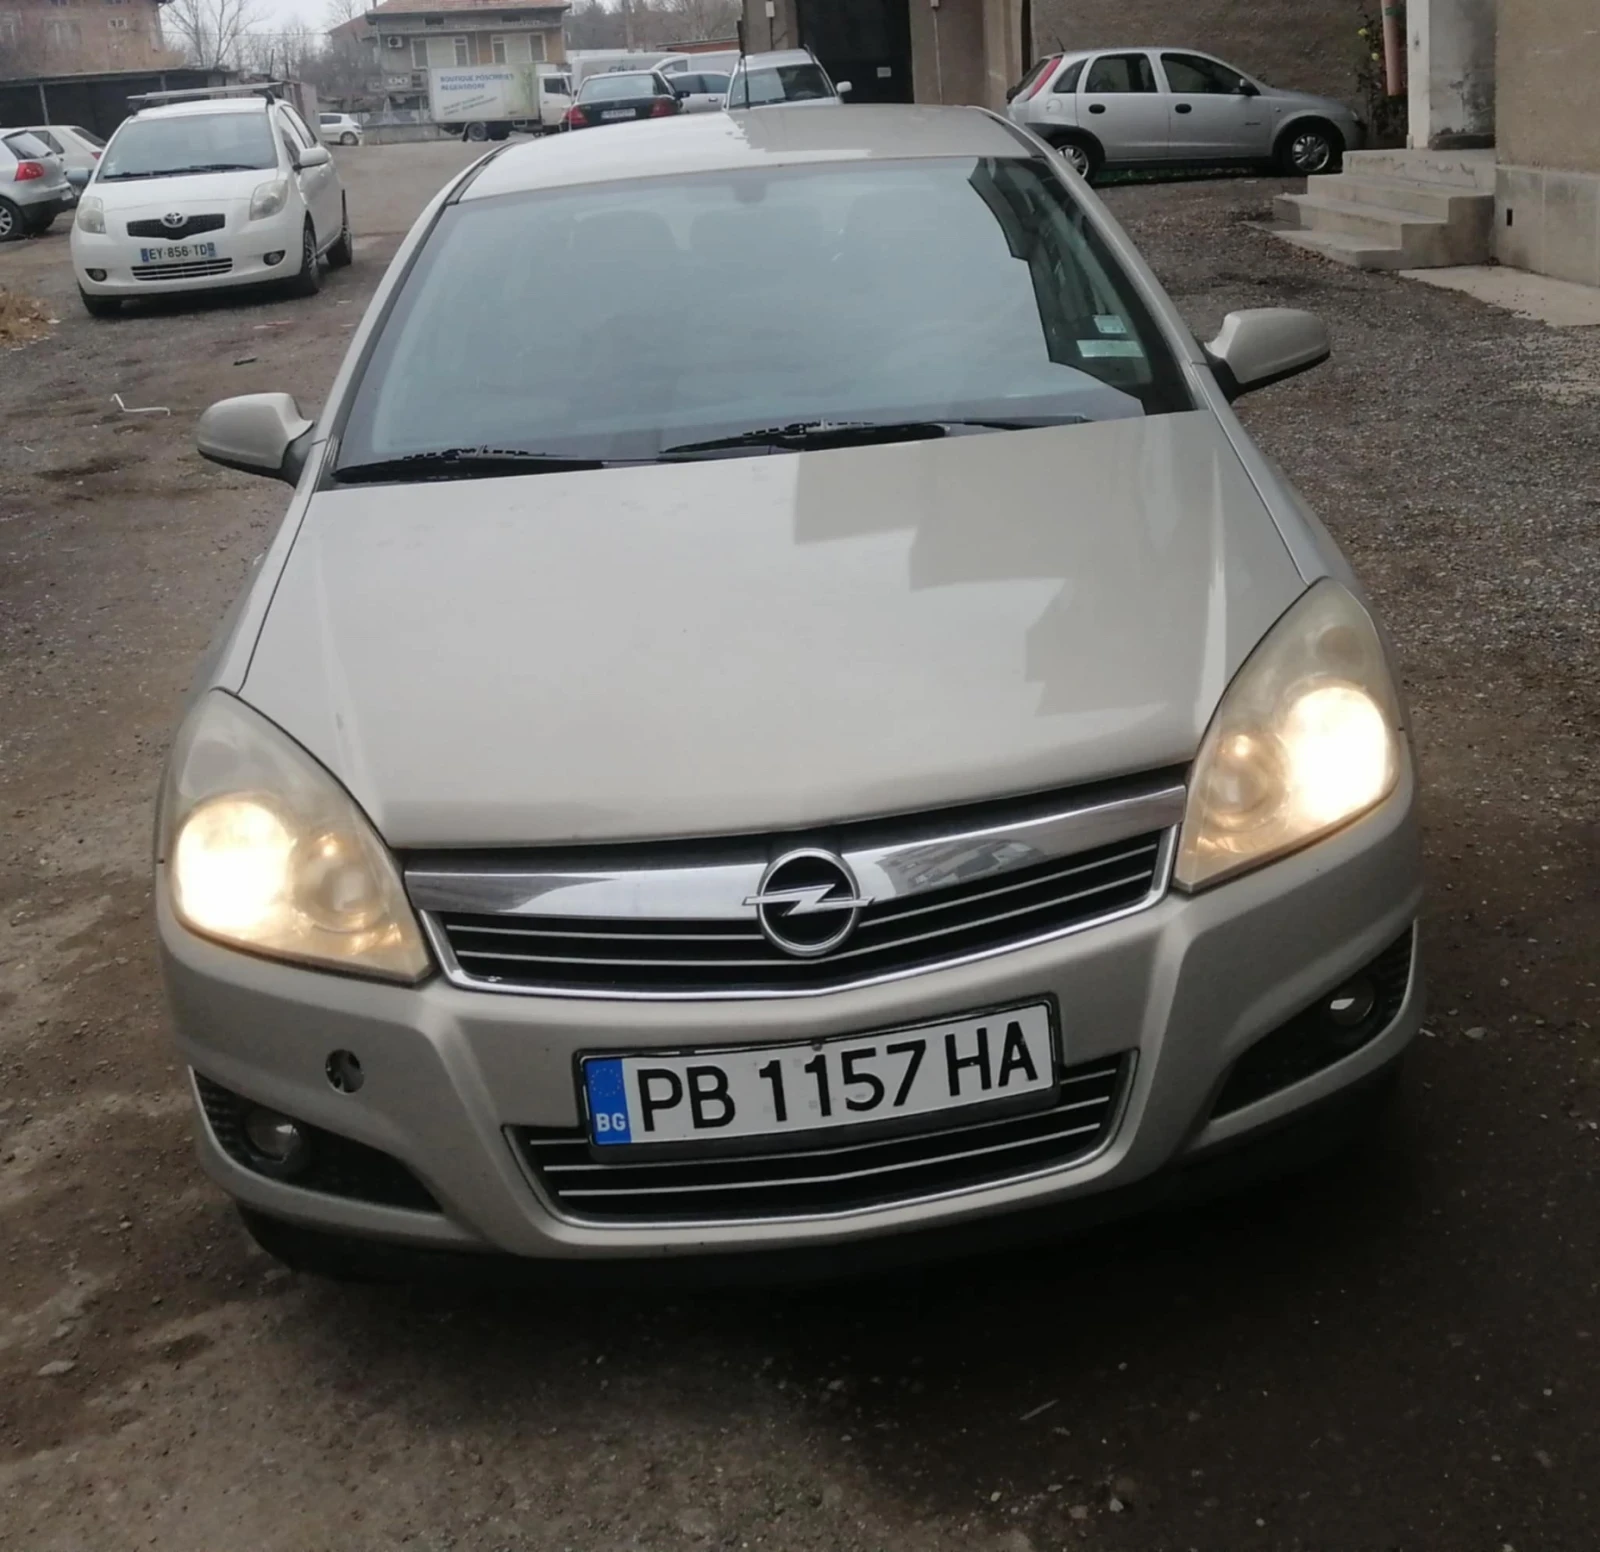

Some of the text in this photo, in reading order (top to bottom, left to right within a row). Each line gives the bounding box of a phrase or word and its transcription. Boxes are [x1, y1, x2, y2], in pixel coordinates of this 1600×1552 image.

[636, 1021, 1039, 1132] PB 1157 HA
[595, 1113, 626, 1132] BG
